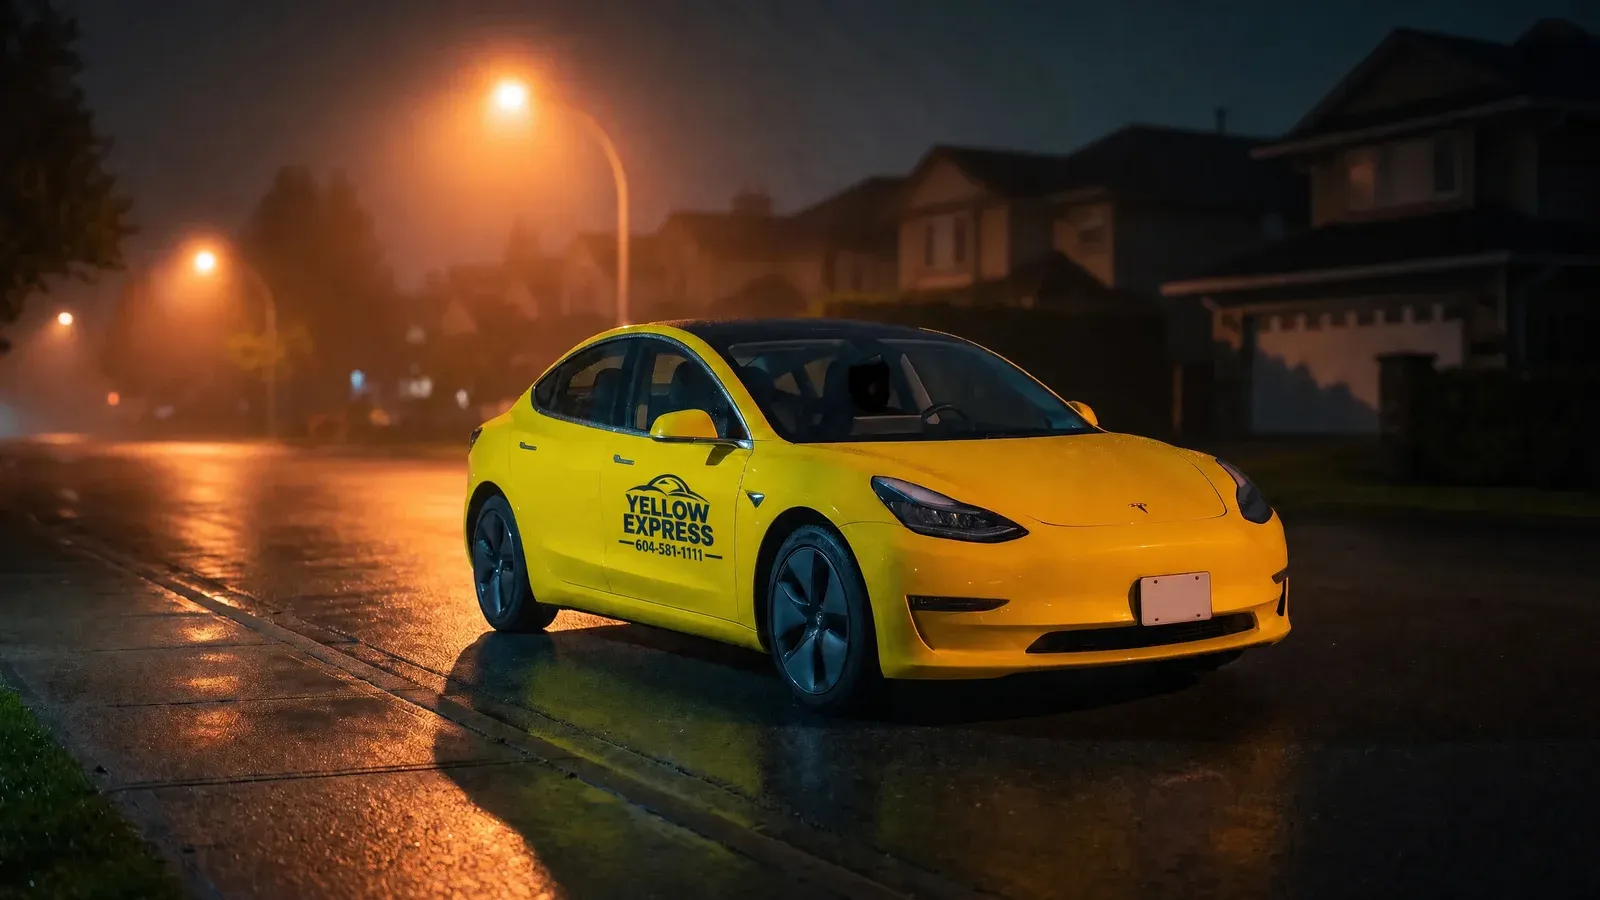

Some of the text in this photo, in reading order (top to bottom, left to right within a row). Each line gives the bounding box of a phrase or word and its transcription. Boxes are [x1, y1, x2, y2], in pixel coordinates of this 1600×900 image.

[626, 494, 710, 523] YELLOW
[624, 514, 714, 546] EXPRESS
[636, 540, 703, 561] 604-581-1111
